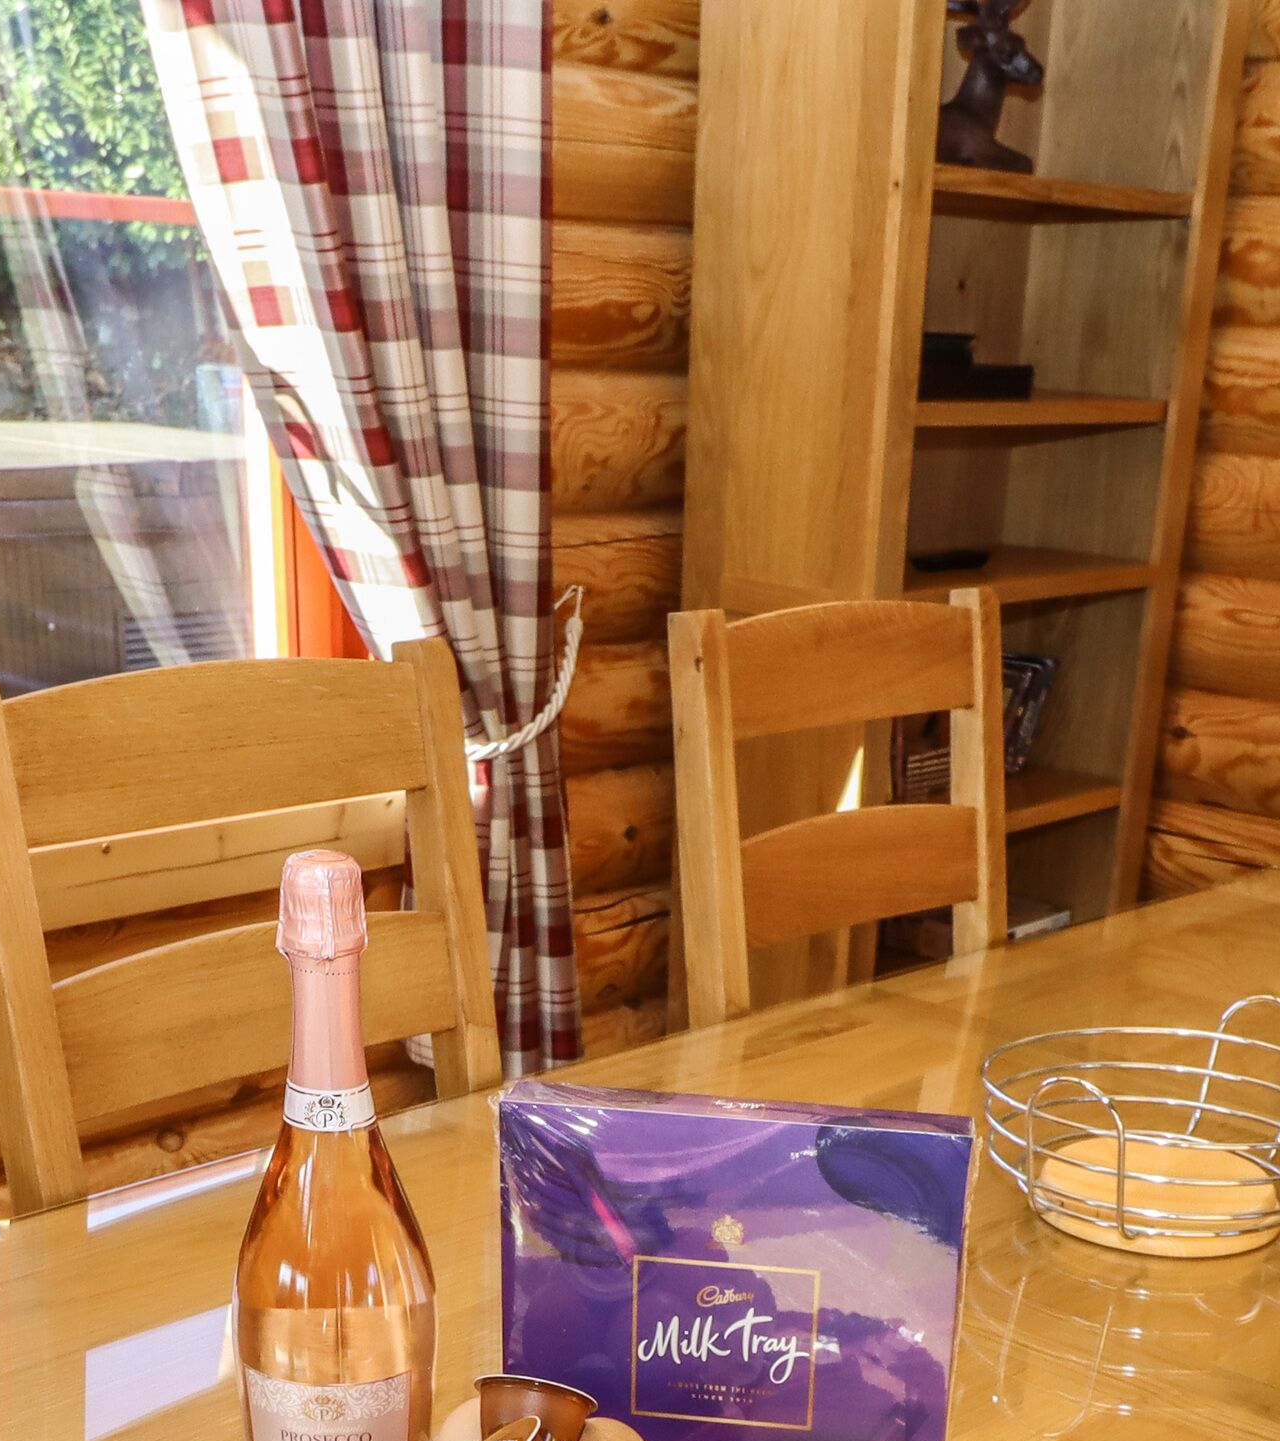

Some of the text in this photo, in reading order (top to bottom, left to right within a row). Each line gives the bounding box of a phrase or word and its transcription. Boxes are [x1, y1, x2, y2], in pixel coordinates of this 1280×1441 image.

[696, 1285, 755, 1308] Cadbury
[637, 1307, 810, 1385] Milk Tray
